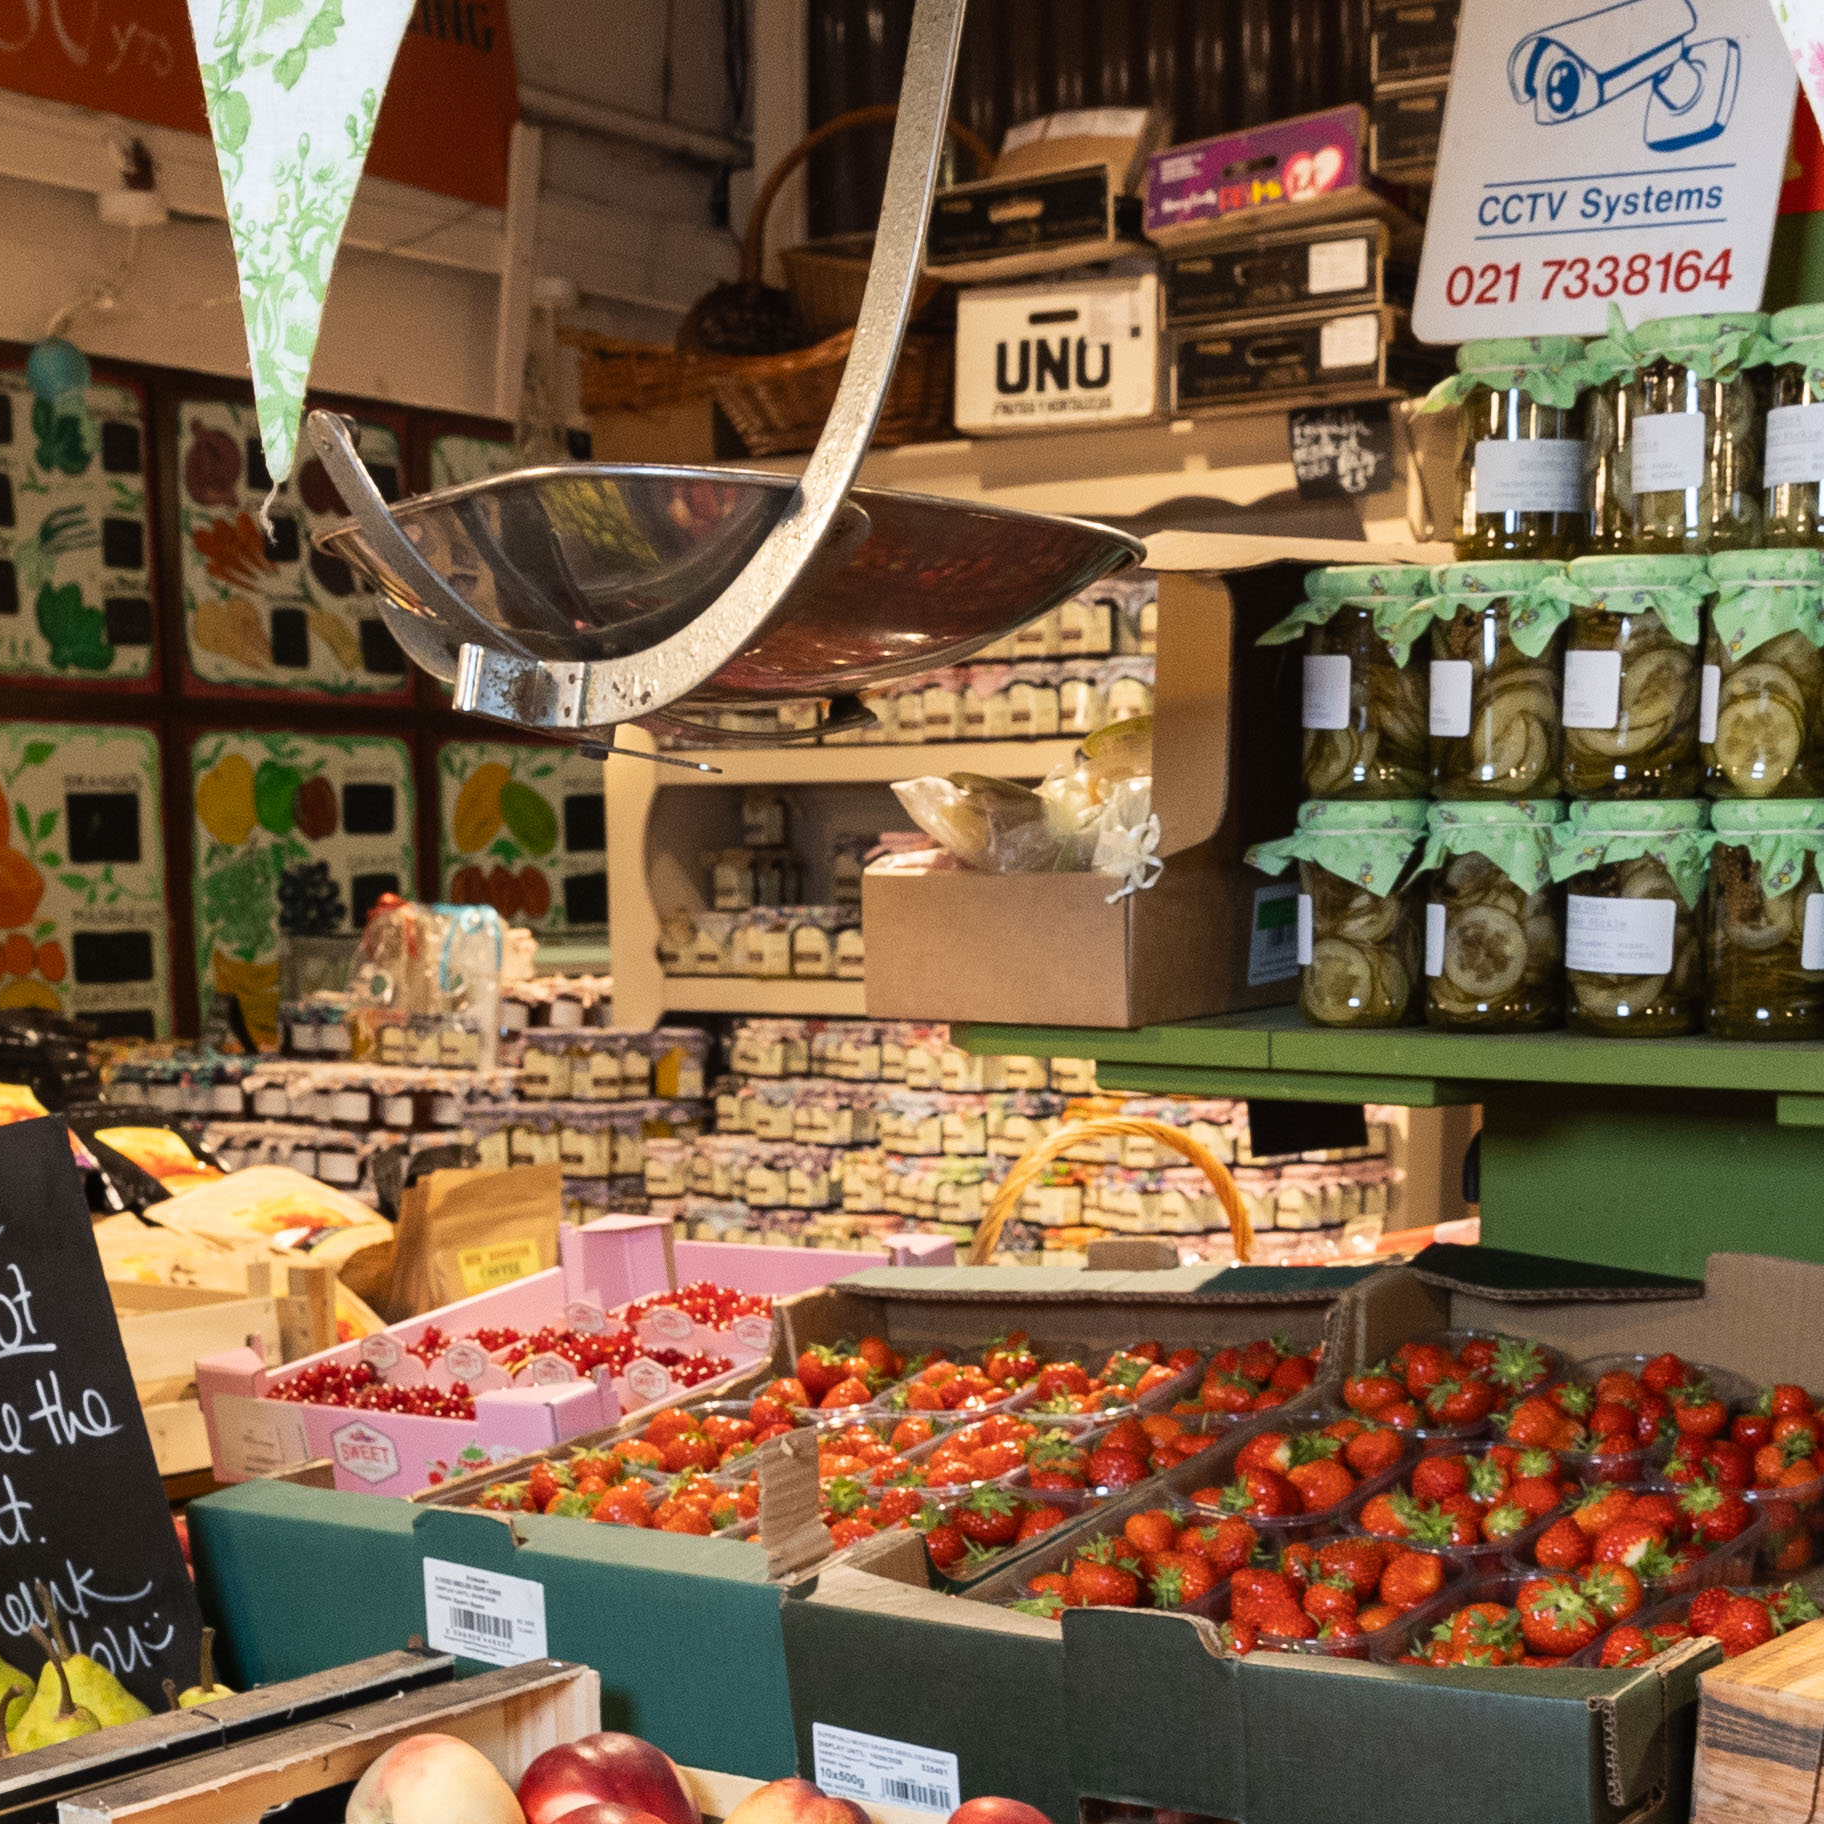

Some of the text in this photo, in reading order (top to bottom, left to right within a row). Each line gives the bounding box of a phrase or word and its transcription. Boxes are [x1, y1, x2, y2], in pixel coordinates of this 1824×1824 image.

[1477, 185, 1723, 227] CCTV Systems
[1445, 248, 1733, 306] 021 7338164
[995, 336, 1111, 395] UNO
[29, 1370, 124, 1444] the
[340, 1444, 391, 1467] SWEET
[820, 1766, 865, 1789] 10x500g
